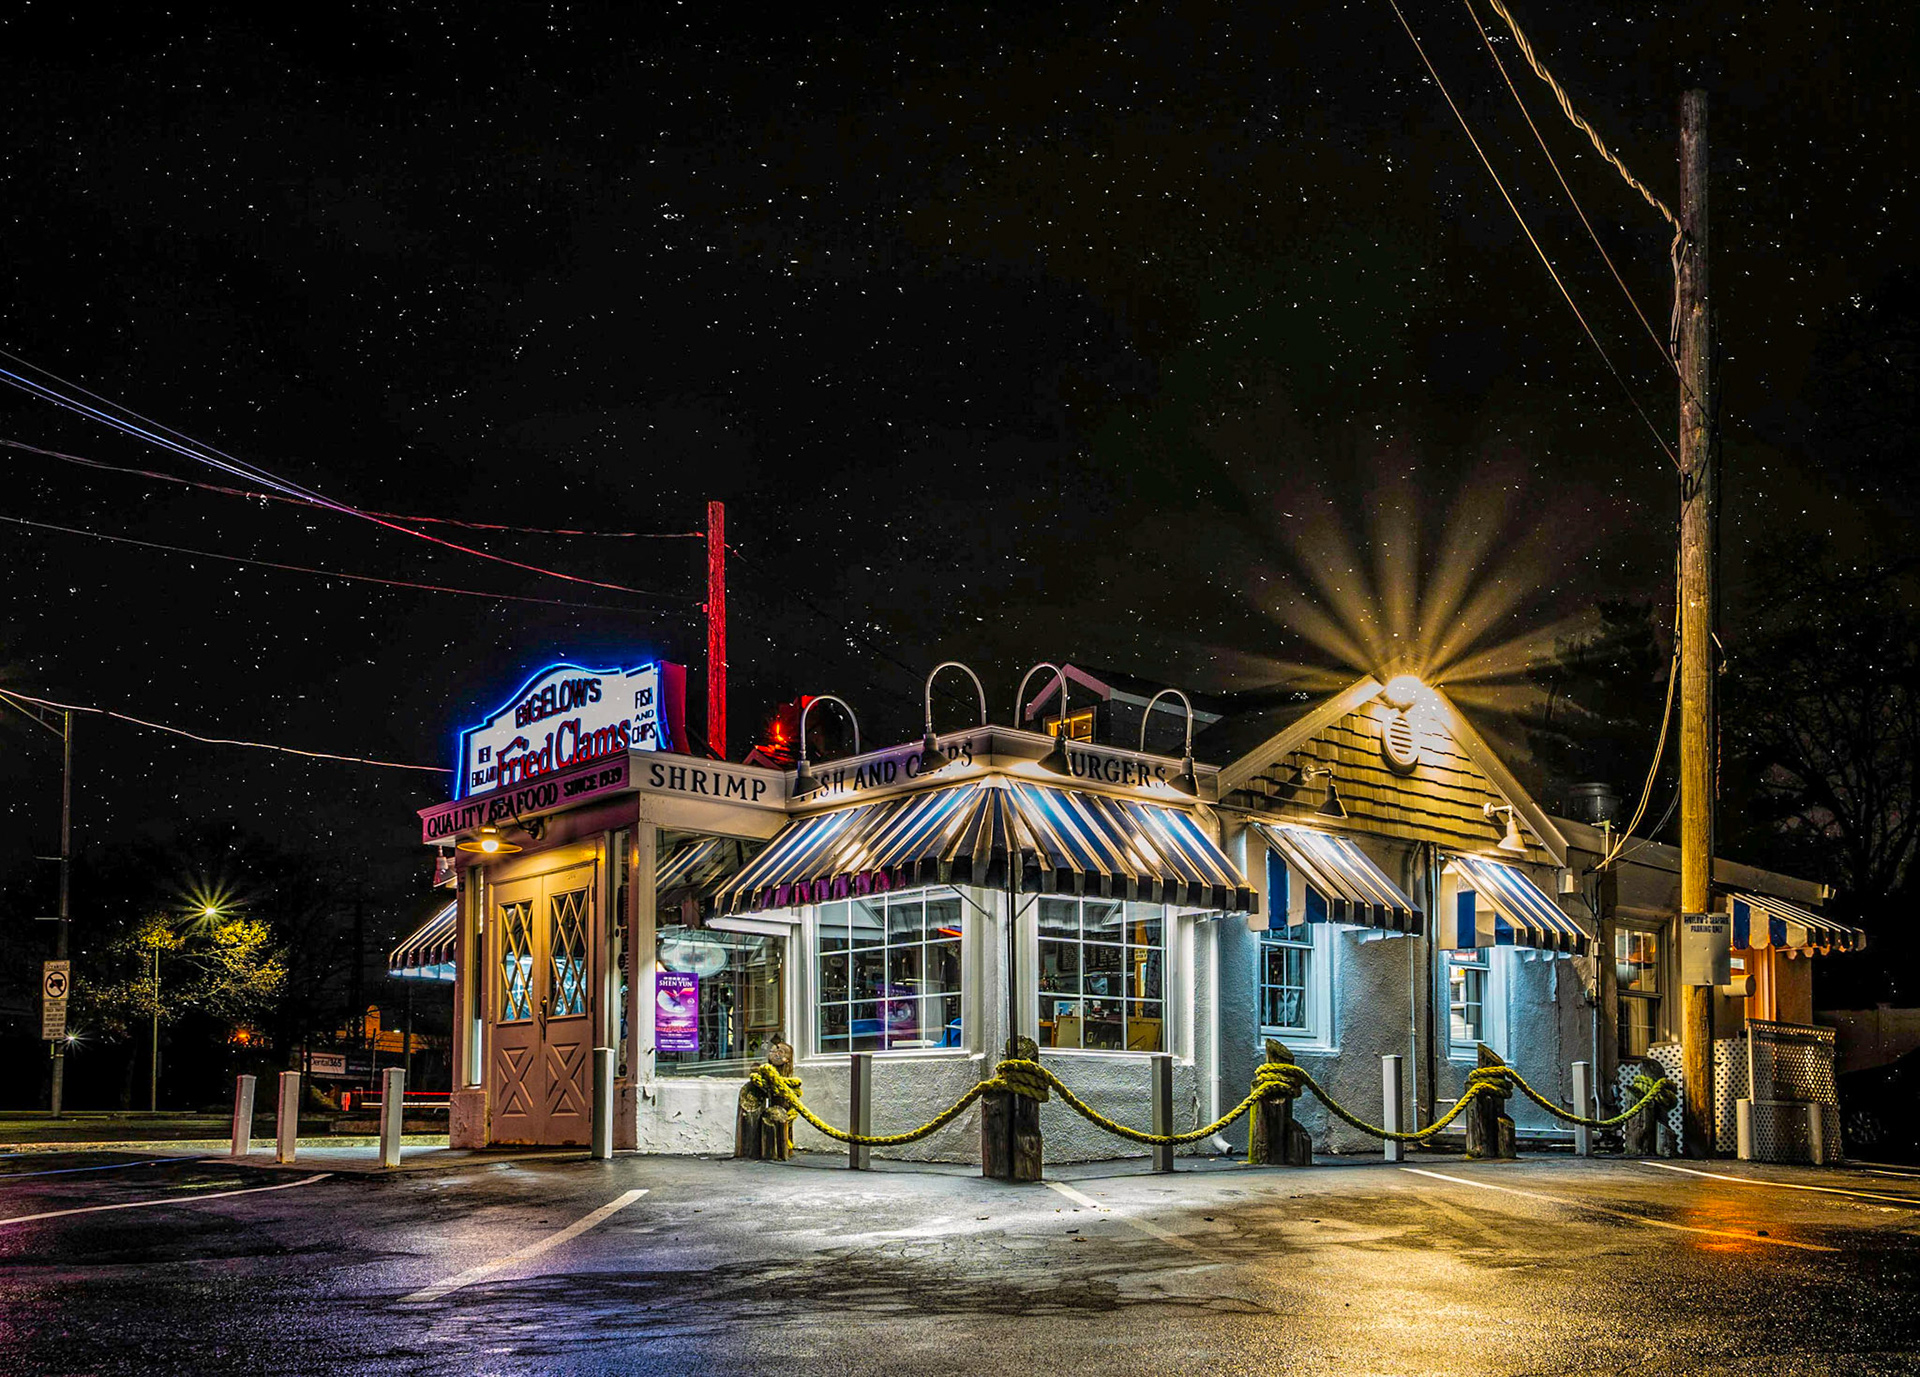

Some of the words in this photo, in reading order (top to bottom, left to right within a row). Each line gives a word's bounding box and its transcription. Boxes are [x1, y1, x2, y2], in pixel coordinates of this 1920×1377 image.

[635, 686, 653, 709] FISH
[635, 709, 654, 722] AND
[632, 721, 656, 744] CHIPS
[496, 732, 554, 788] Fried
[555, 717, 631, 769] Clams
[853, 760, 897, 791] AND
[906, 741, 973, 778] CPS
[649, 763, 767, 802] SHRIMP
[427, 802, 486, 838] QUALITY
